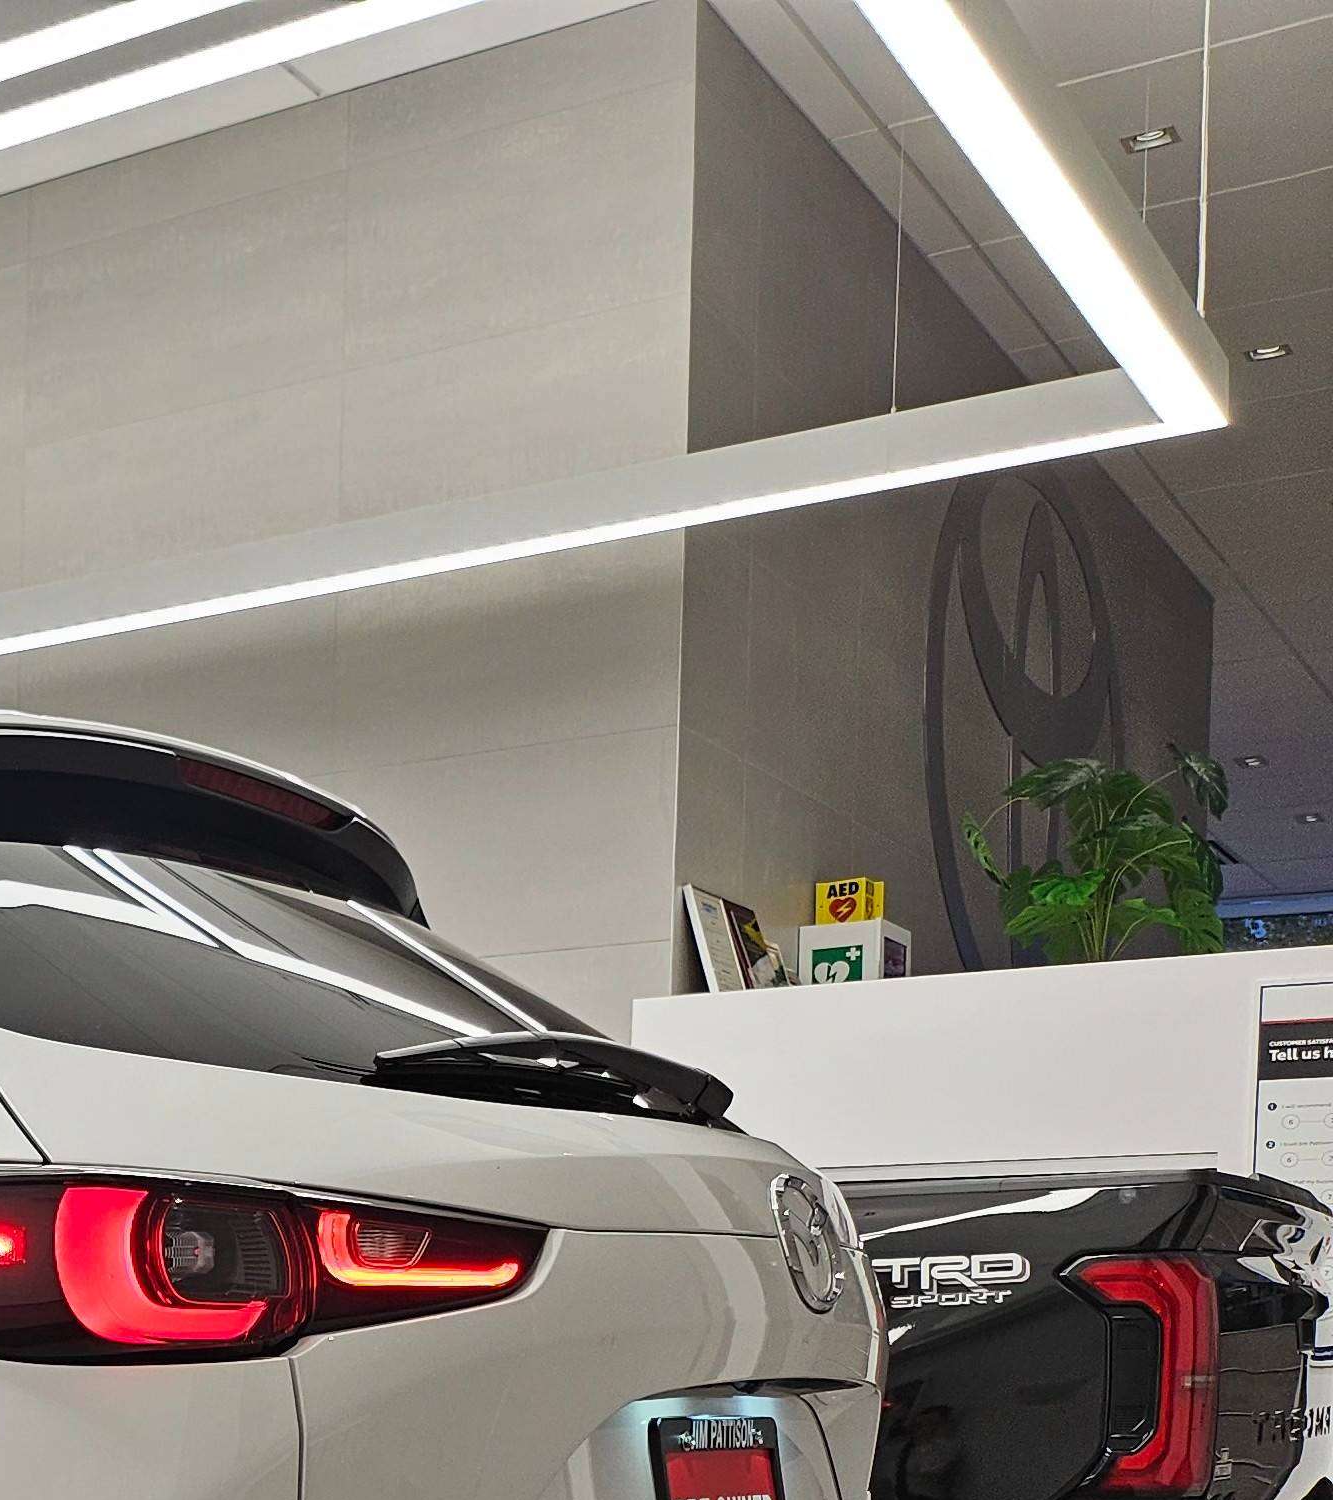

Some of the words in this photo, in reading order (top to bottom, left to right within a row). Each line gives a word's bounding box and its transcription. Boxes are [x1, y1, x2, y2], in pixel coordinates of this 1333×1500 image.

[827, 881, 860, 899] AED
[1269, 1047, 1298, 1061] Tell
[1301, 1050, 1321, 1060] us
[871, 1253, 1028, 1292] TRD
[891, 1290, 1013, 1308] SPORT
[710, 1419, 755, 1449] PATTISON
